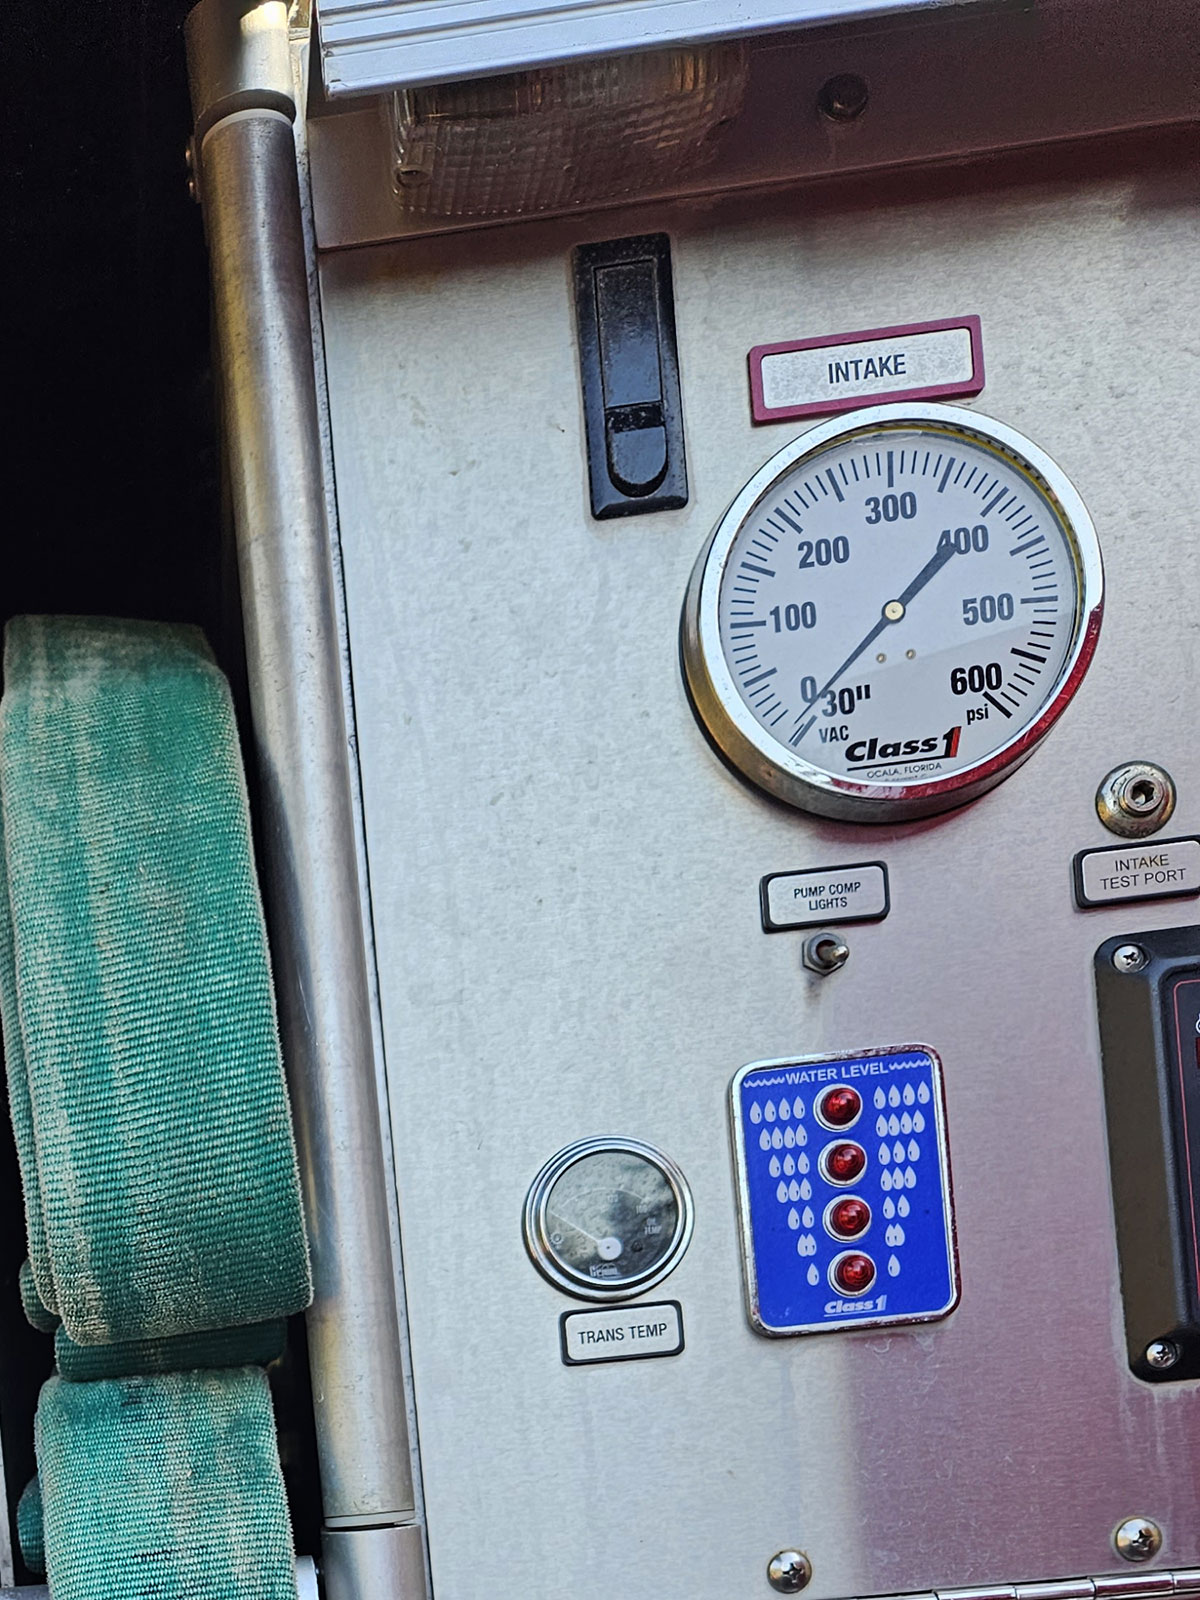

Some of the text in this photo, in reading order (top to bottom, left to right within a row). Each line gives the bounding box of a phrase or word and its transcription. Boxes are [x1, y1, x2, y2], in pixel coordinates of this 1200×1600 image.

[828, 354, 907, 384] INTAKE
[865, 492, 917, 525] 300
[936, 525, 988, 555] 400
[798, 536, 850, 569] 200
[769, 601, 816, 633] 100
[963, 593, 1014, 626] 500
[800, 676, 817, 702] 0
[951, 663, 1001, 695] 600
[966, 704, 989, 725] psi
[818, 725, 849, 743] VAC
[904, 762, 942, 774] FLORIDA
[1115, 854, 1169, 872] INTAKE
[794, 882, 861, 899] PUMP COMP
[1100, 868, 1186, 890] TEST PORT
[809, 897, 848, 911] LIGHTS
[785, 1062, 890, 1085] WATER LEVEL
[577, 1323, 668, 1345] TRANS TEMP
